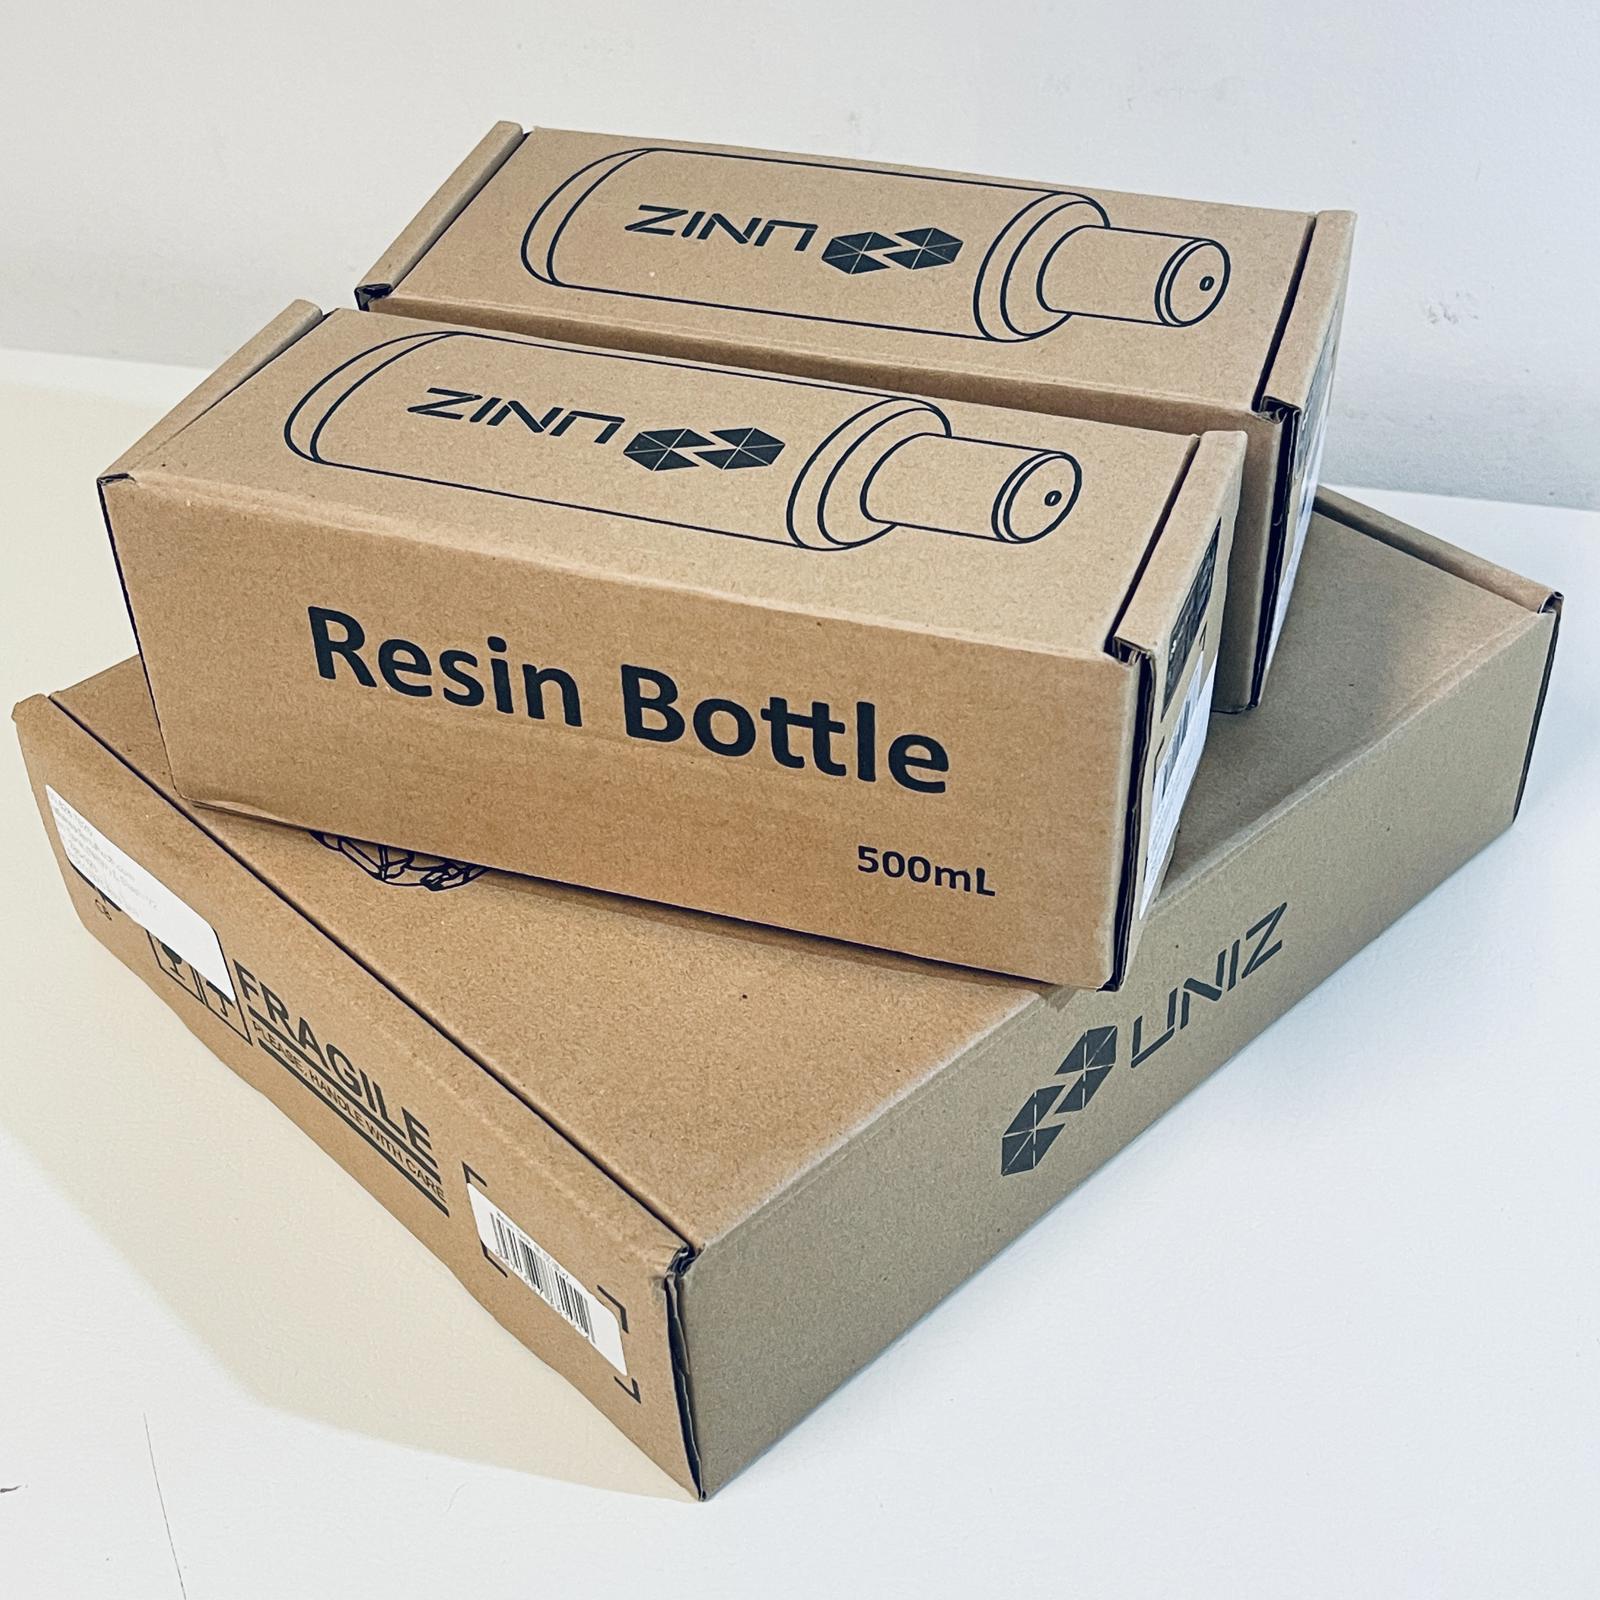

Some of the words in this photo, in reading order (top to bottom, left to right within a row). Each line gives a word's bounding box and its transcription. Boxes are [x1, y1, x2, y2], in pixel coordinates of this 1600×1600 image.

[625, 204, 818, 252] UNIZ
[407, 387, 625, 444] UNIZ
[308, 606, 582, 727] Resin
[621, 664, 949, 793] Bottle
[857, 844, 995, 897] 500mL
[1131, 902, 1287, 1068] UNIZ
[233, 959, 439, 1169] FRAGILE
[309, 1070, 366, 1129] HANDLE
[364, 1121, 403, 1164] WITH
[404, 1158, 448, 1203] CARE
